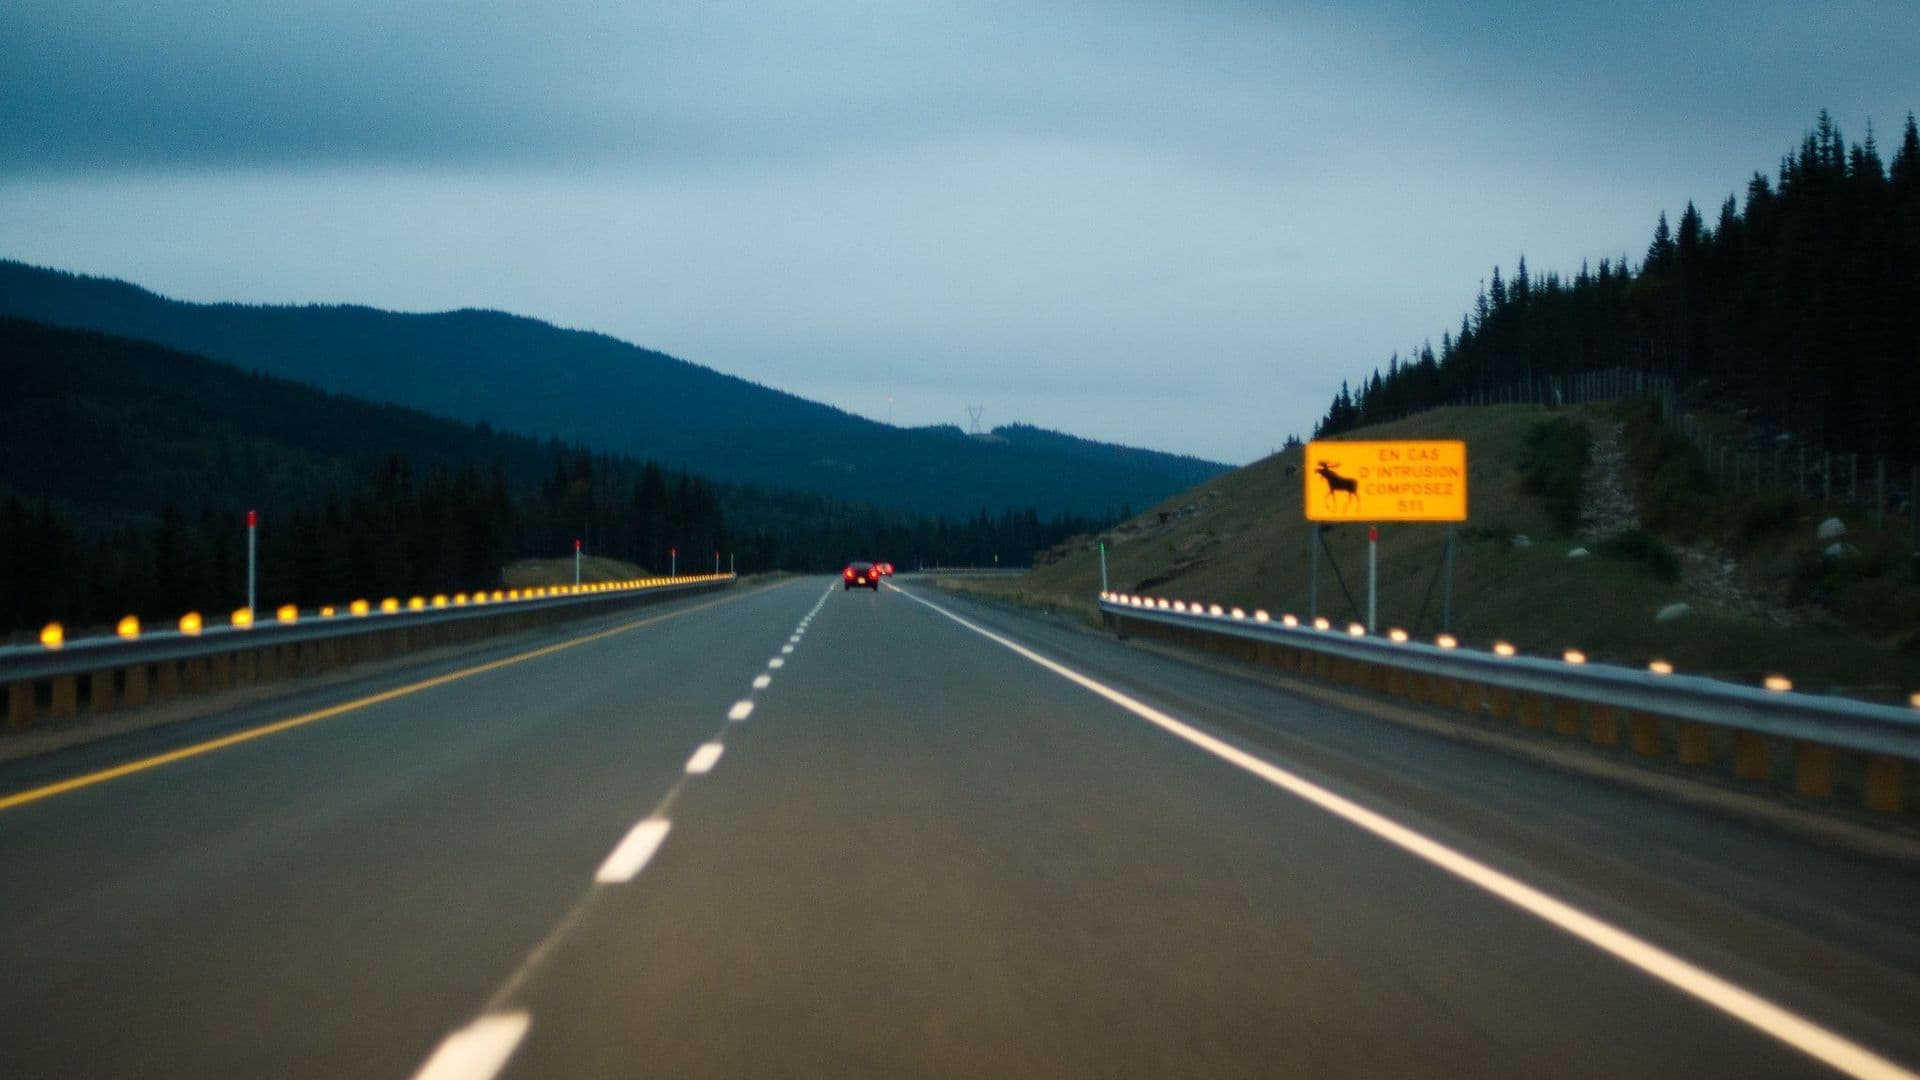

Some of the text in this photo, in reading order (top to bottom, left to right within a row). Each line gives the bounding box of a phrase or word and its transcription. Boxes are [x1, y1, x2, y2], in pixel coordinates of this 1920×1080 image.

[1379, 448, 1440, 461] EN CAS
[1359, 466, 1460, 478] D'INTRUSION
[1365, 483, 1454, 496] COMPOSEZ
[1398, 500, 1424, 512] 511
